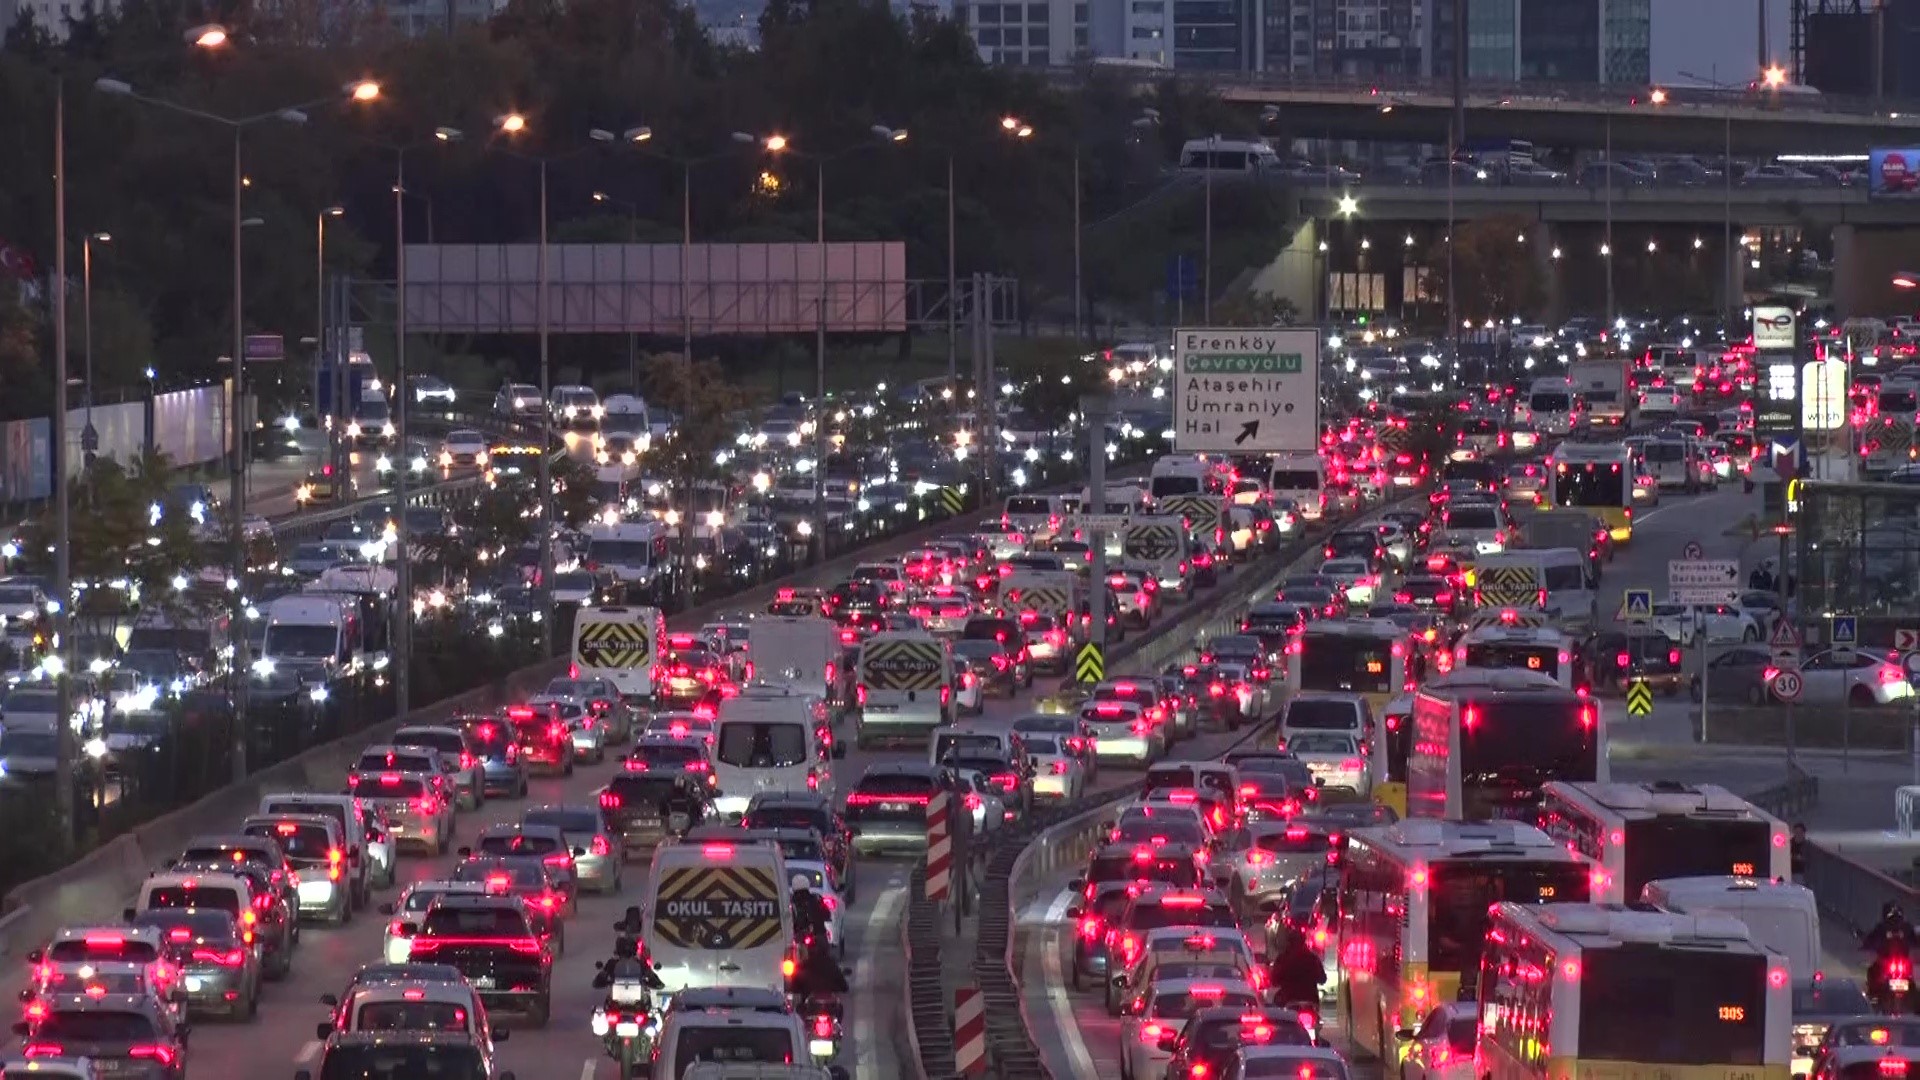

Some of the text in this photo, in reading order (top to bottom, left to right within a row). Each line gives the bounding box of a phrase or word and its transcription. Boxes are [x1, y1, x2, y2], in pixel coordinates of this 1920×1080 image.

[1187, 335, 1276, 353] Erenköy
[1186, 355, 1297, 372] Çevreyolu
[1187, 377, 1283, 393] Ataşehir
[1187, 395, 1294, 416] Ümraniye
[1186, 419, 1220, 434] Hal
[586, 641, 610, 649] OKUL
[1779, 677, 1797, 692] 30
[667, 901, 774, 918] OKUL TAŞITI
